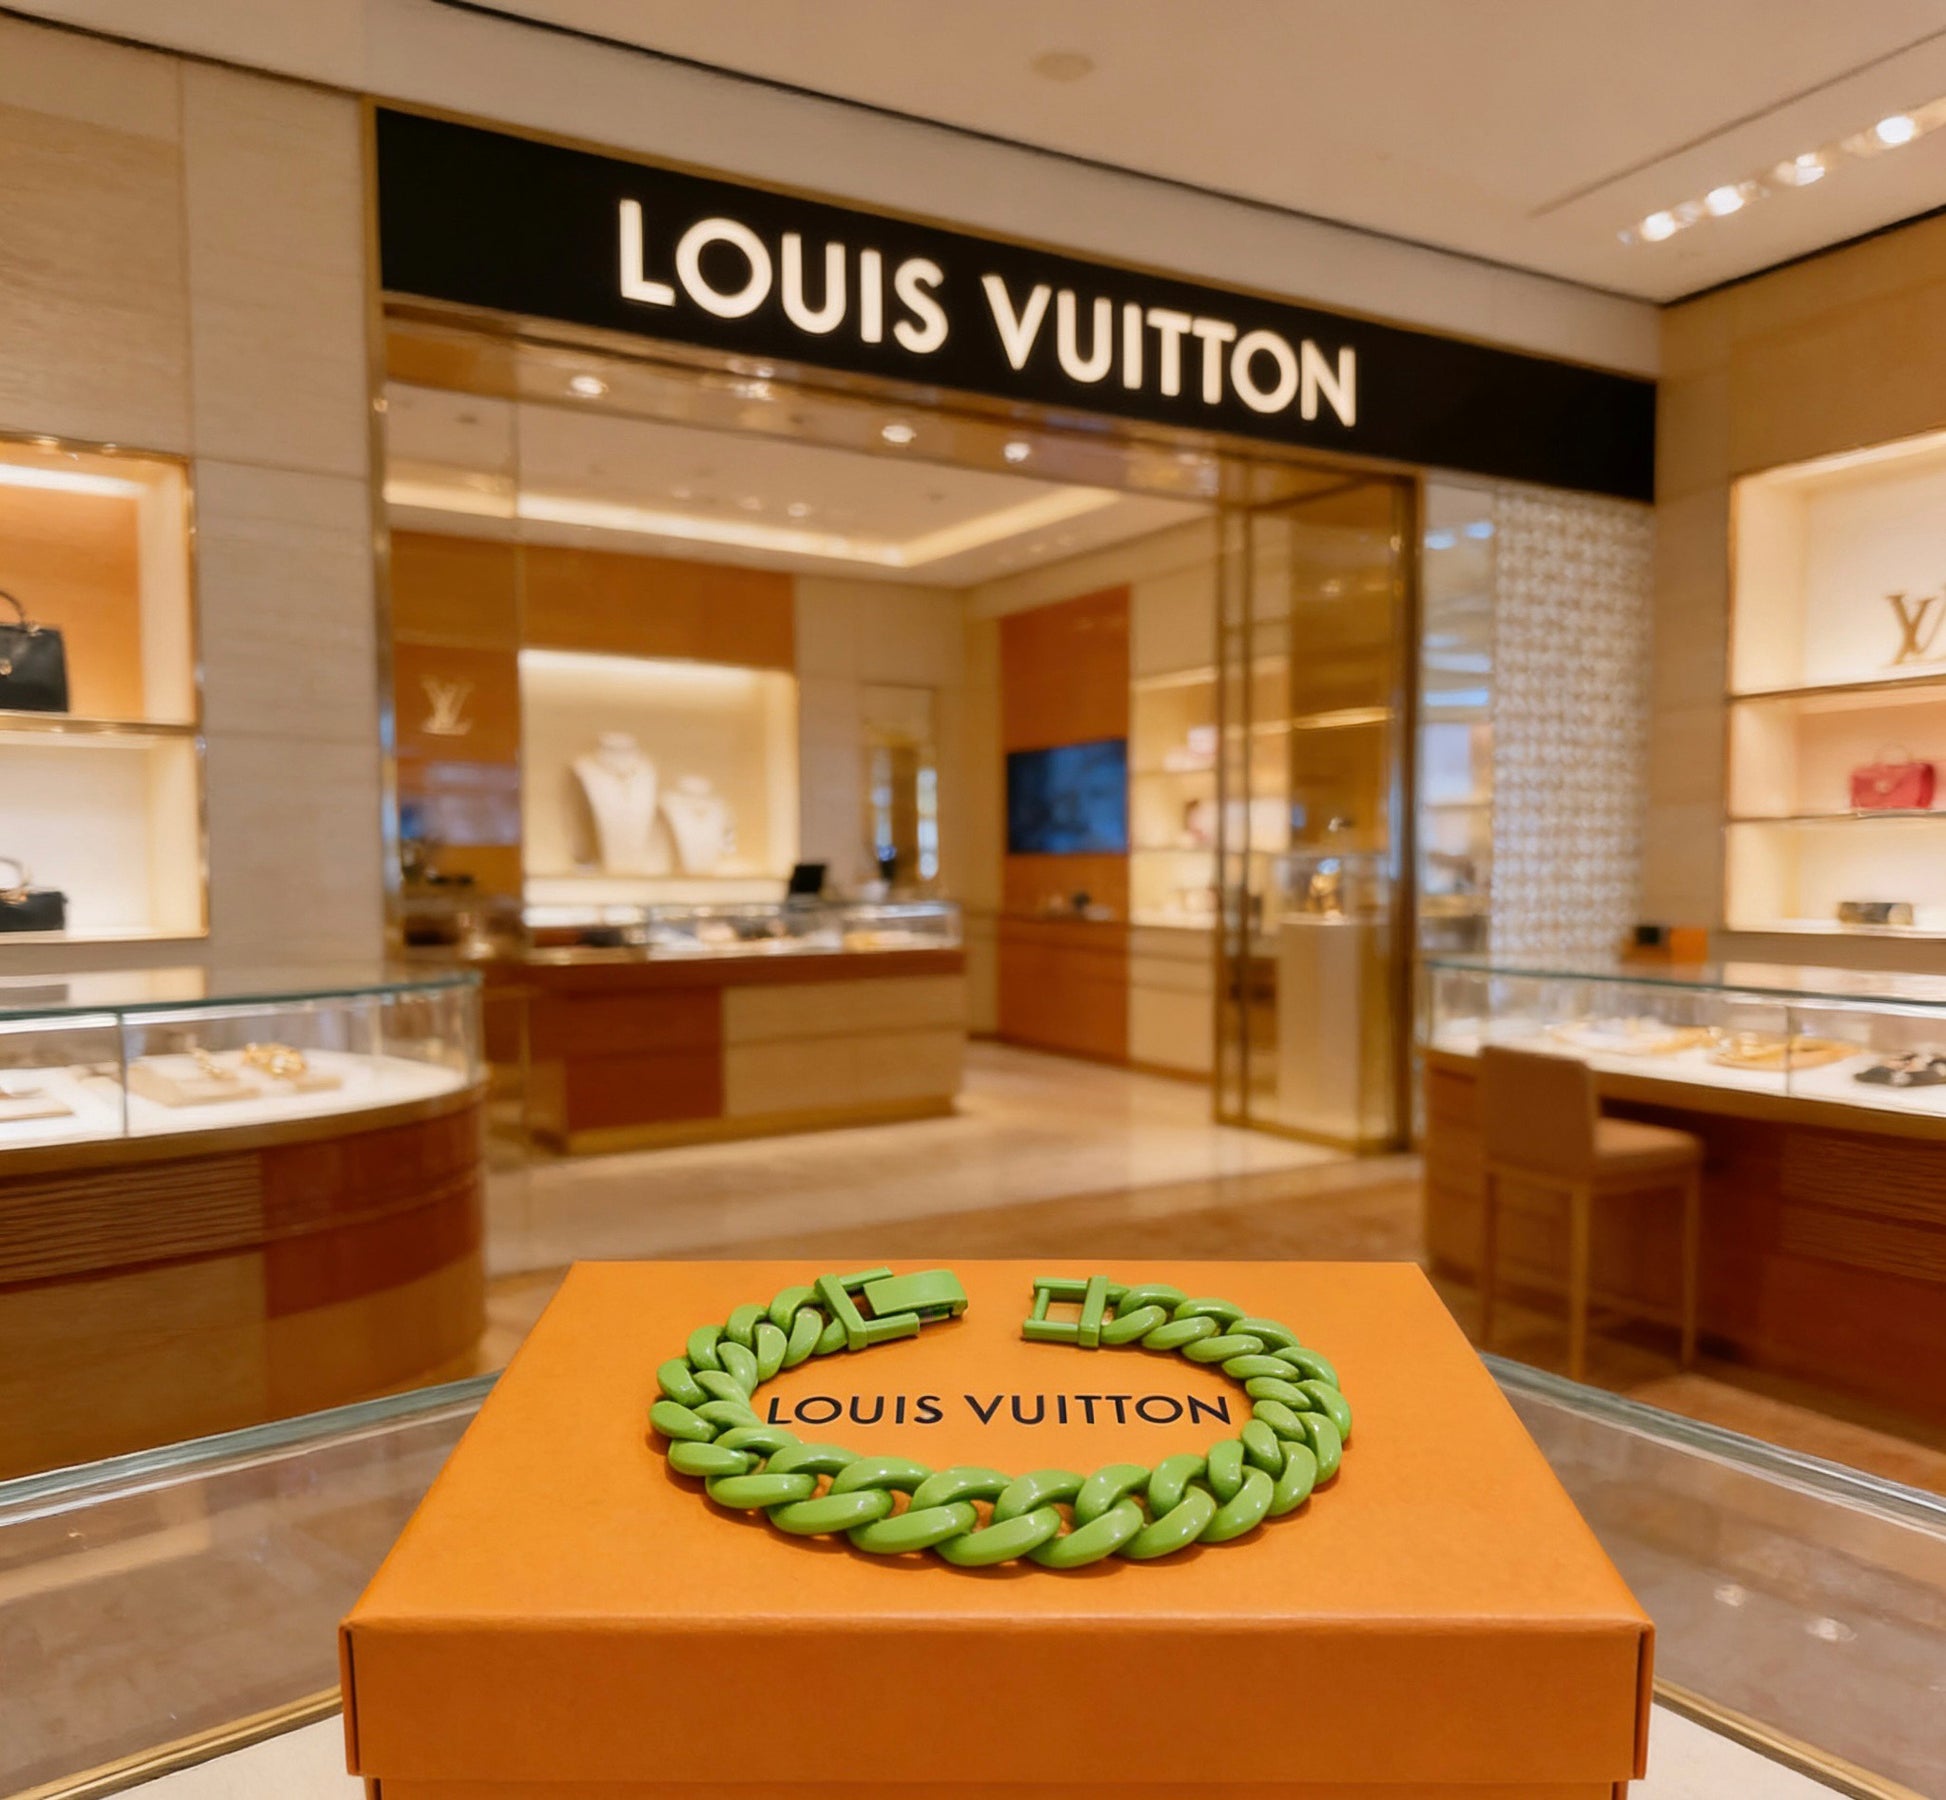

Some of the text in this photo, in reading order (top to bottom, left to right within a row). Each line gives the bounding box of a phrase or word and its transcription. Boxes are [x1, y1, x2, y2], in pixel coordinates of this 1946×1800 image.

[619, 200, 1355, 426] LOUIS VUITTON
[767, 1395, 1231, 1425] LOUIS VUITTON
